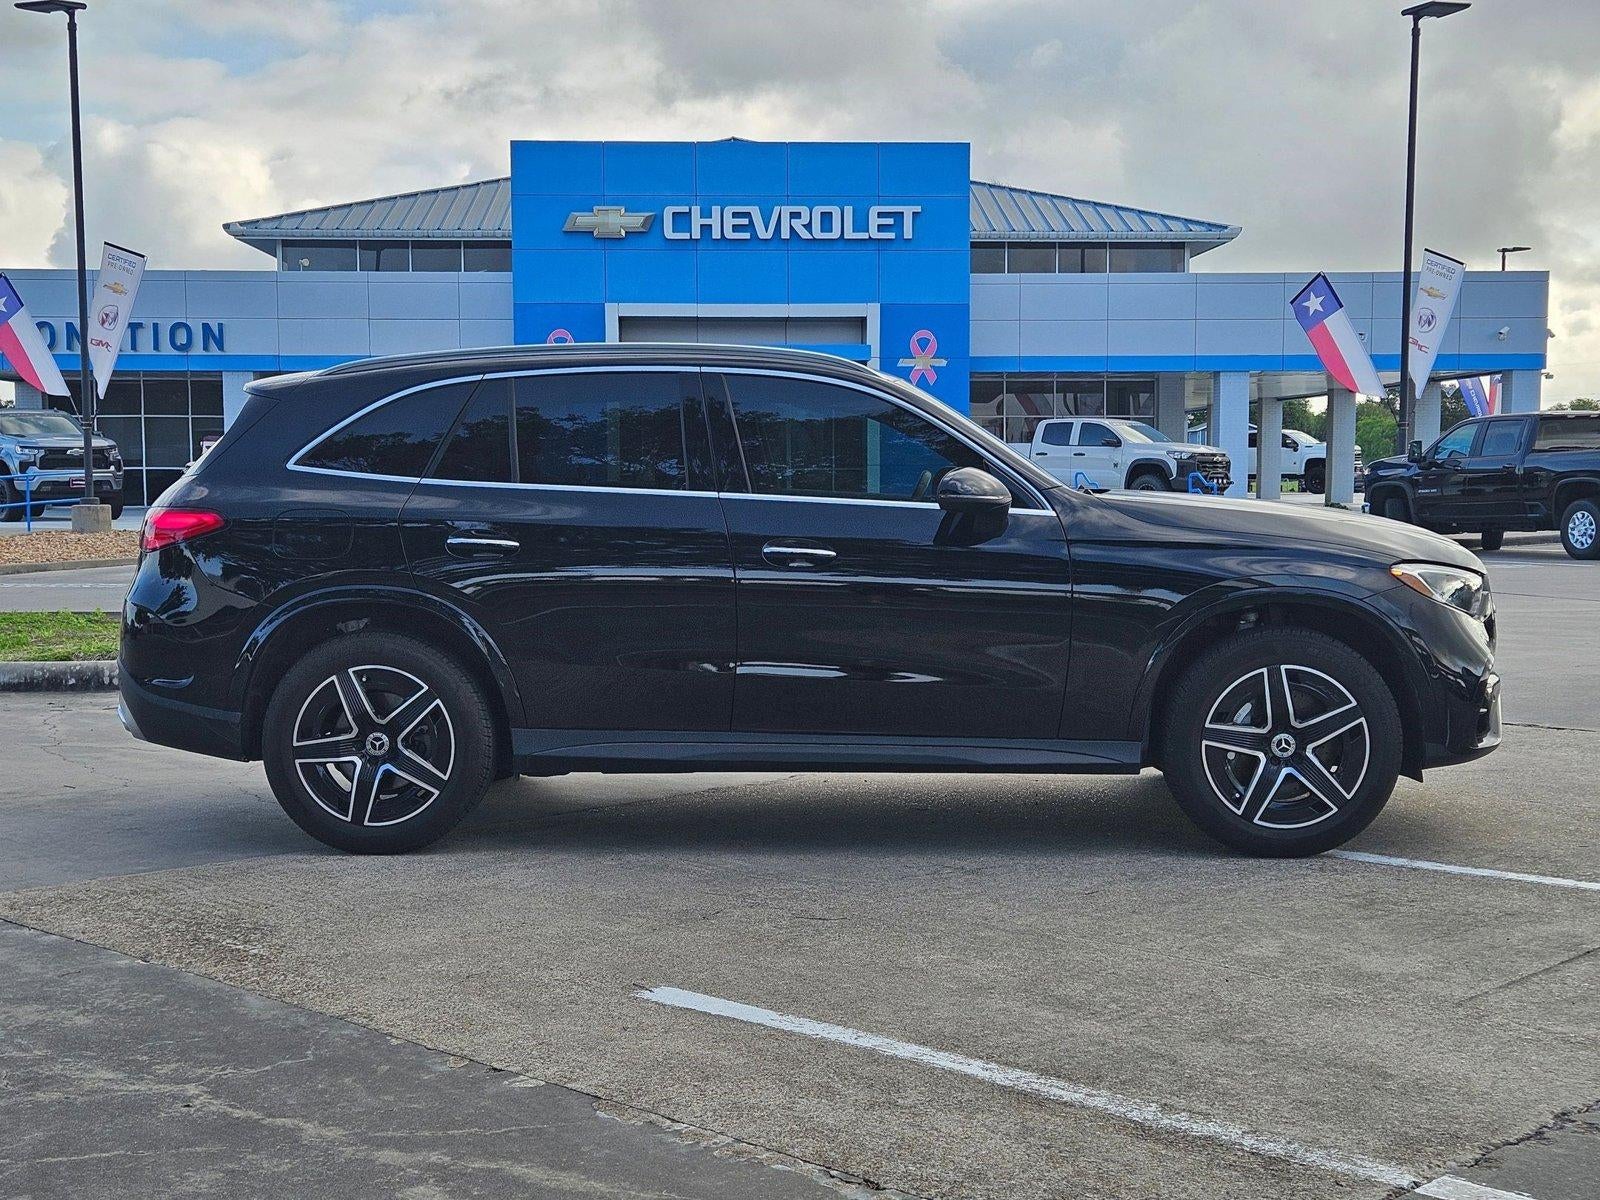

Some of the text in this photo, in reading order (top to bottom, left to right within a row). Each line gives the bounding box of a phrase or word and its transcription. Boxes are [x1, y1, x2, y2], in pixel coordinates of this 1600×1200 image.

[663, 205, 922, 240] CHEVROLET
[107, 253, 137, 269] CERTIFIED
[1426, 258, 1456, 275] CERTIFIED
[90, 338, 112, 353] GMC
